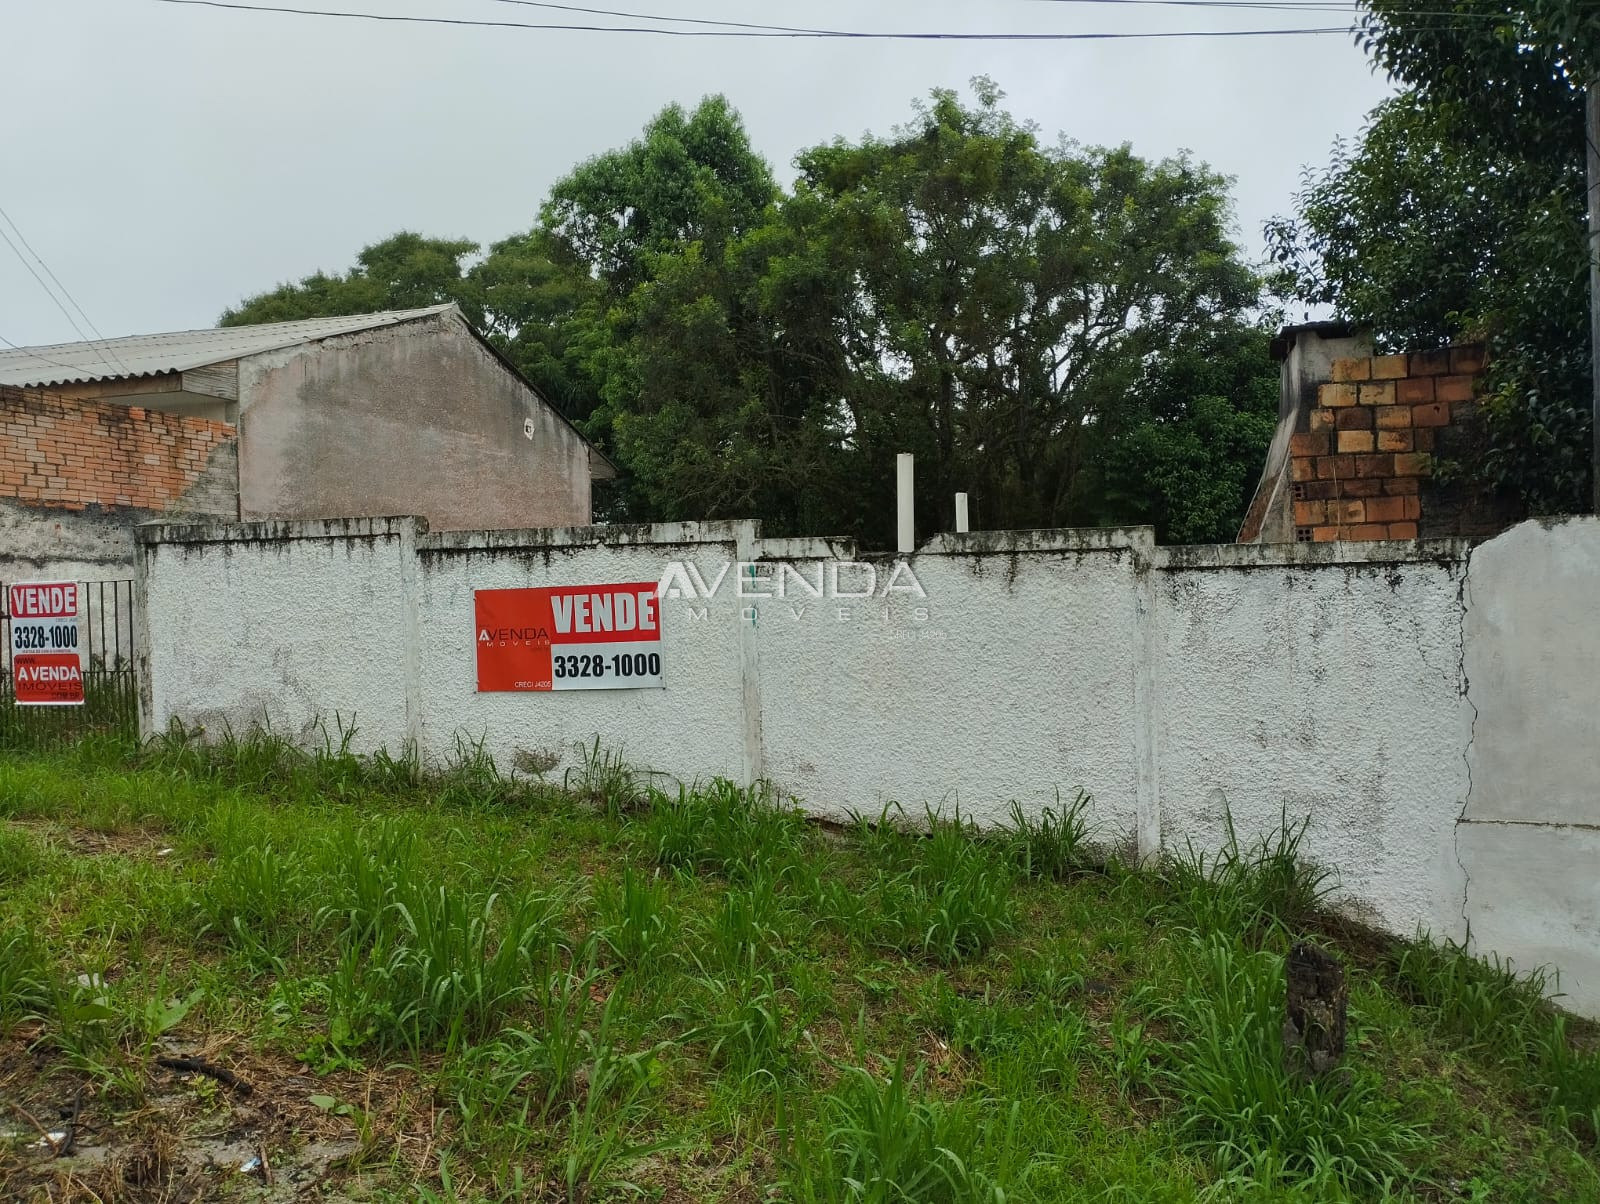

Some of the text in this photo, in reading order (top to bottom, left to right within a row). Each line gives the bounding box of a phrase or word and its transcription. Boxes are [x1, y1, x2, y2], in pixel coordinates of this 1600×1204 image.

[13, 587, 75, 614] VENDE
[551, 592, 656, 633] VENDE
[14, 625, 77, 648] 3328-1000
[479, 627, 549, 640] AVENDA
[554, 653, 661, 677] 3328-1000
